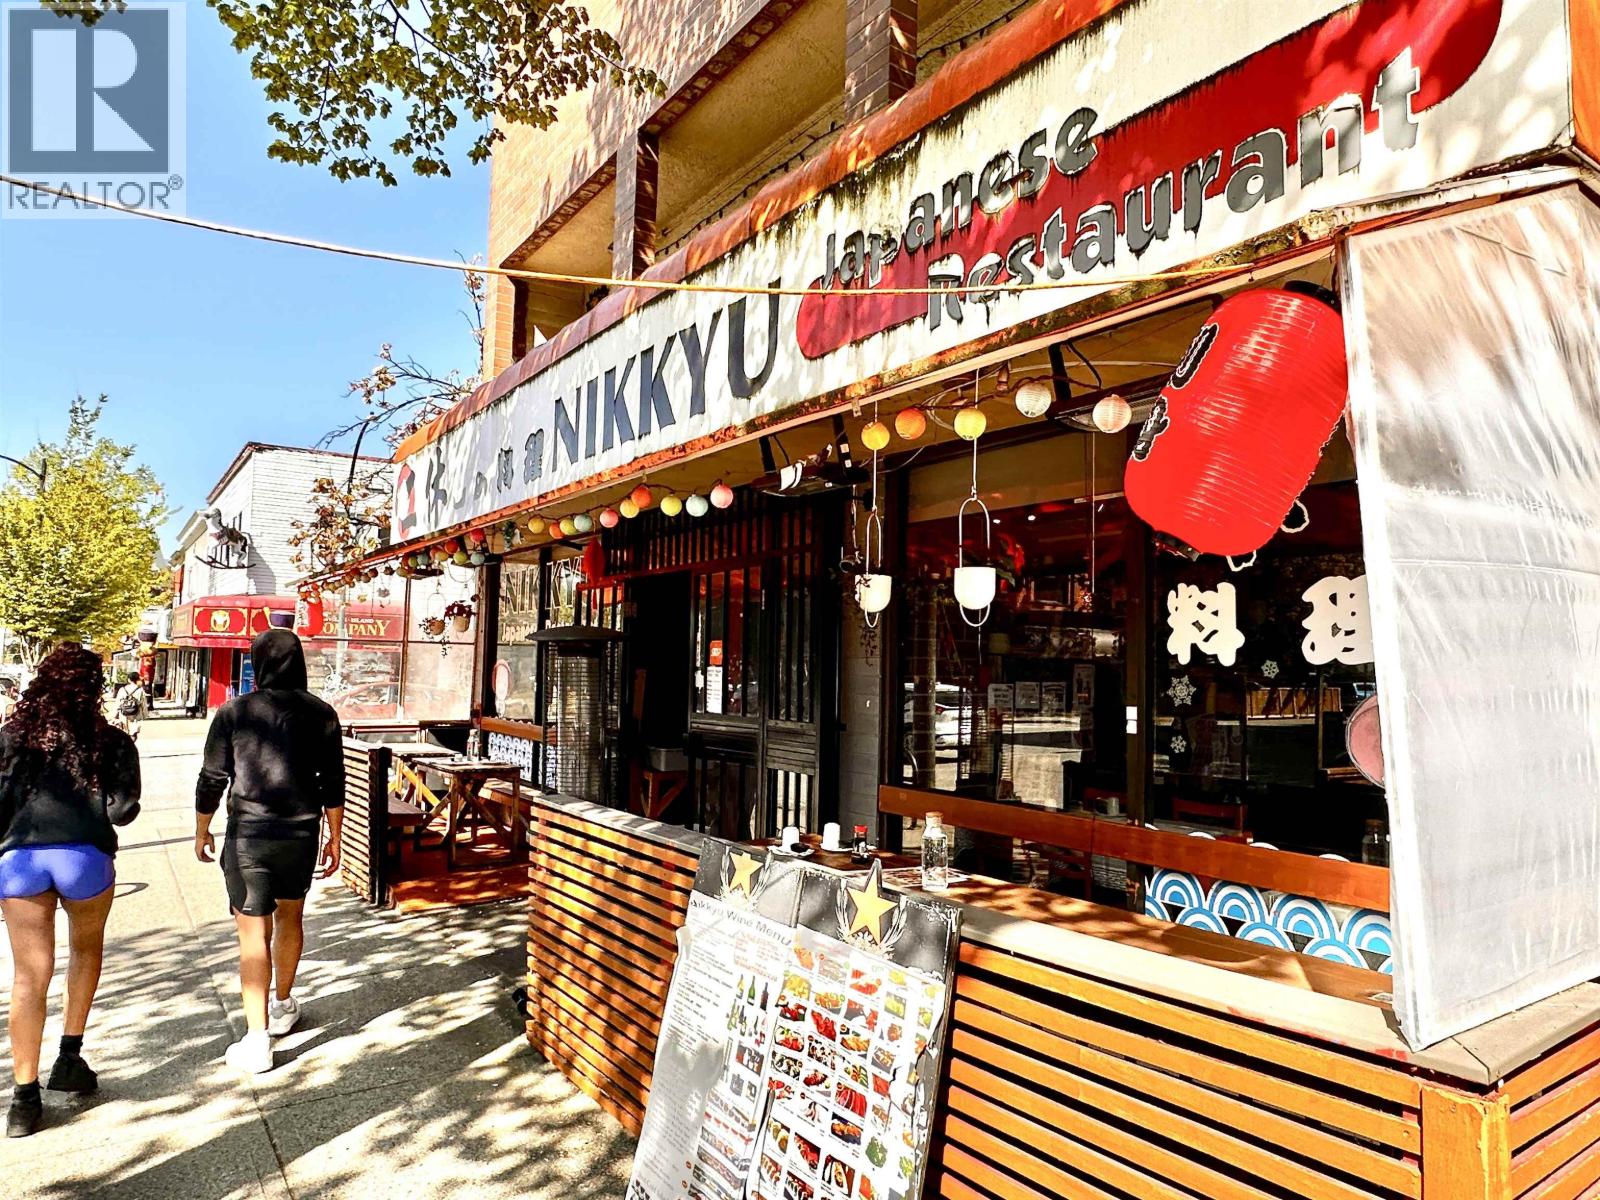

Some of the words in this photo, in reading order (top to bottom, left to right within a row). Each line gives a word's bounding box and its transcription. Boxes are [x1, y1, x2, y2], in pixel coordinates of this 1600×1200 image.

[821, 106, 1099, 291] Japanese
[927, 46, 1421, 333] Restaurant
[552, 277, 781, 472] NIKKYU
[322, 619, 391, 637] OPANY
[726, 910, 754, 928] Wine
[755, 920, 792, 946] Menu
